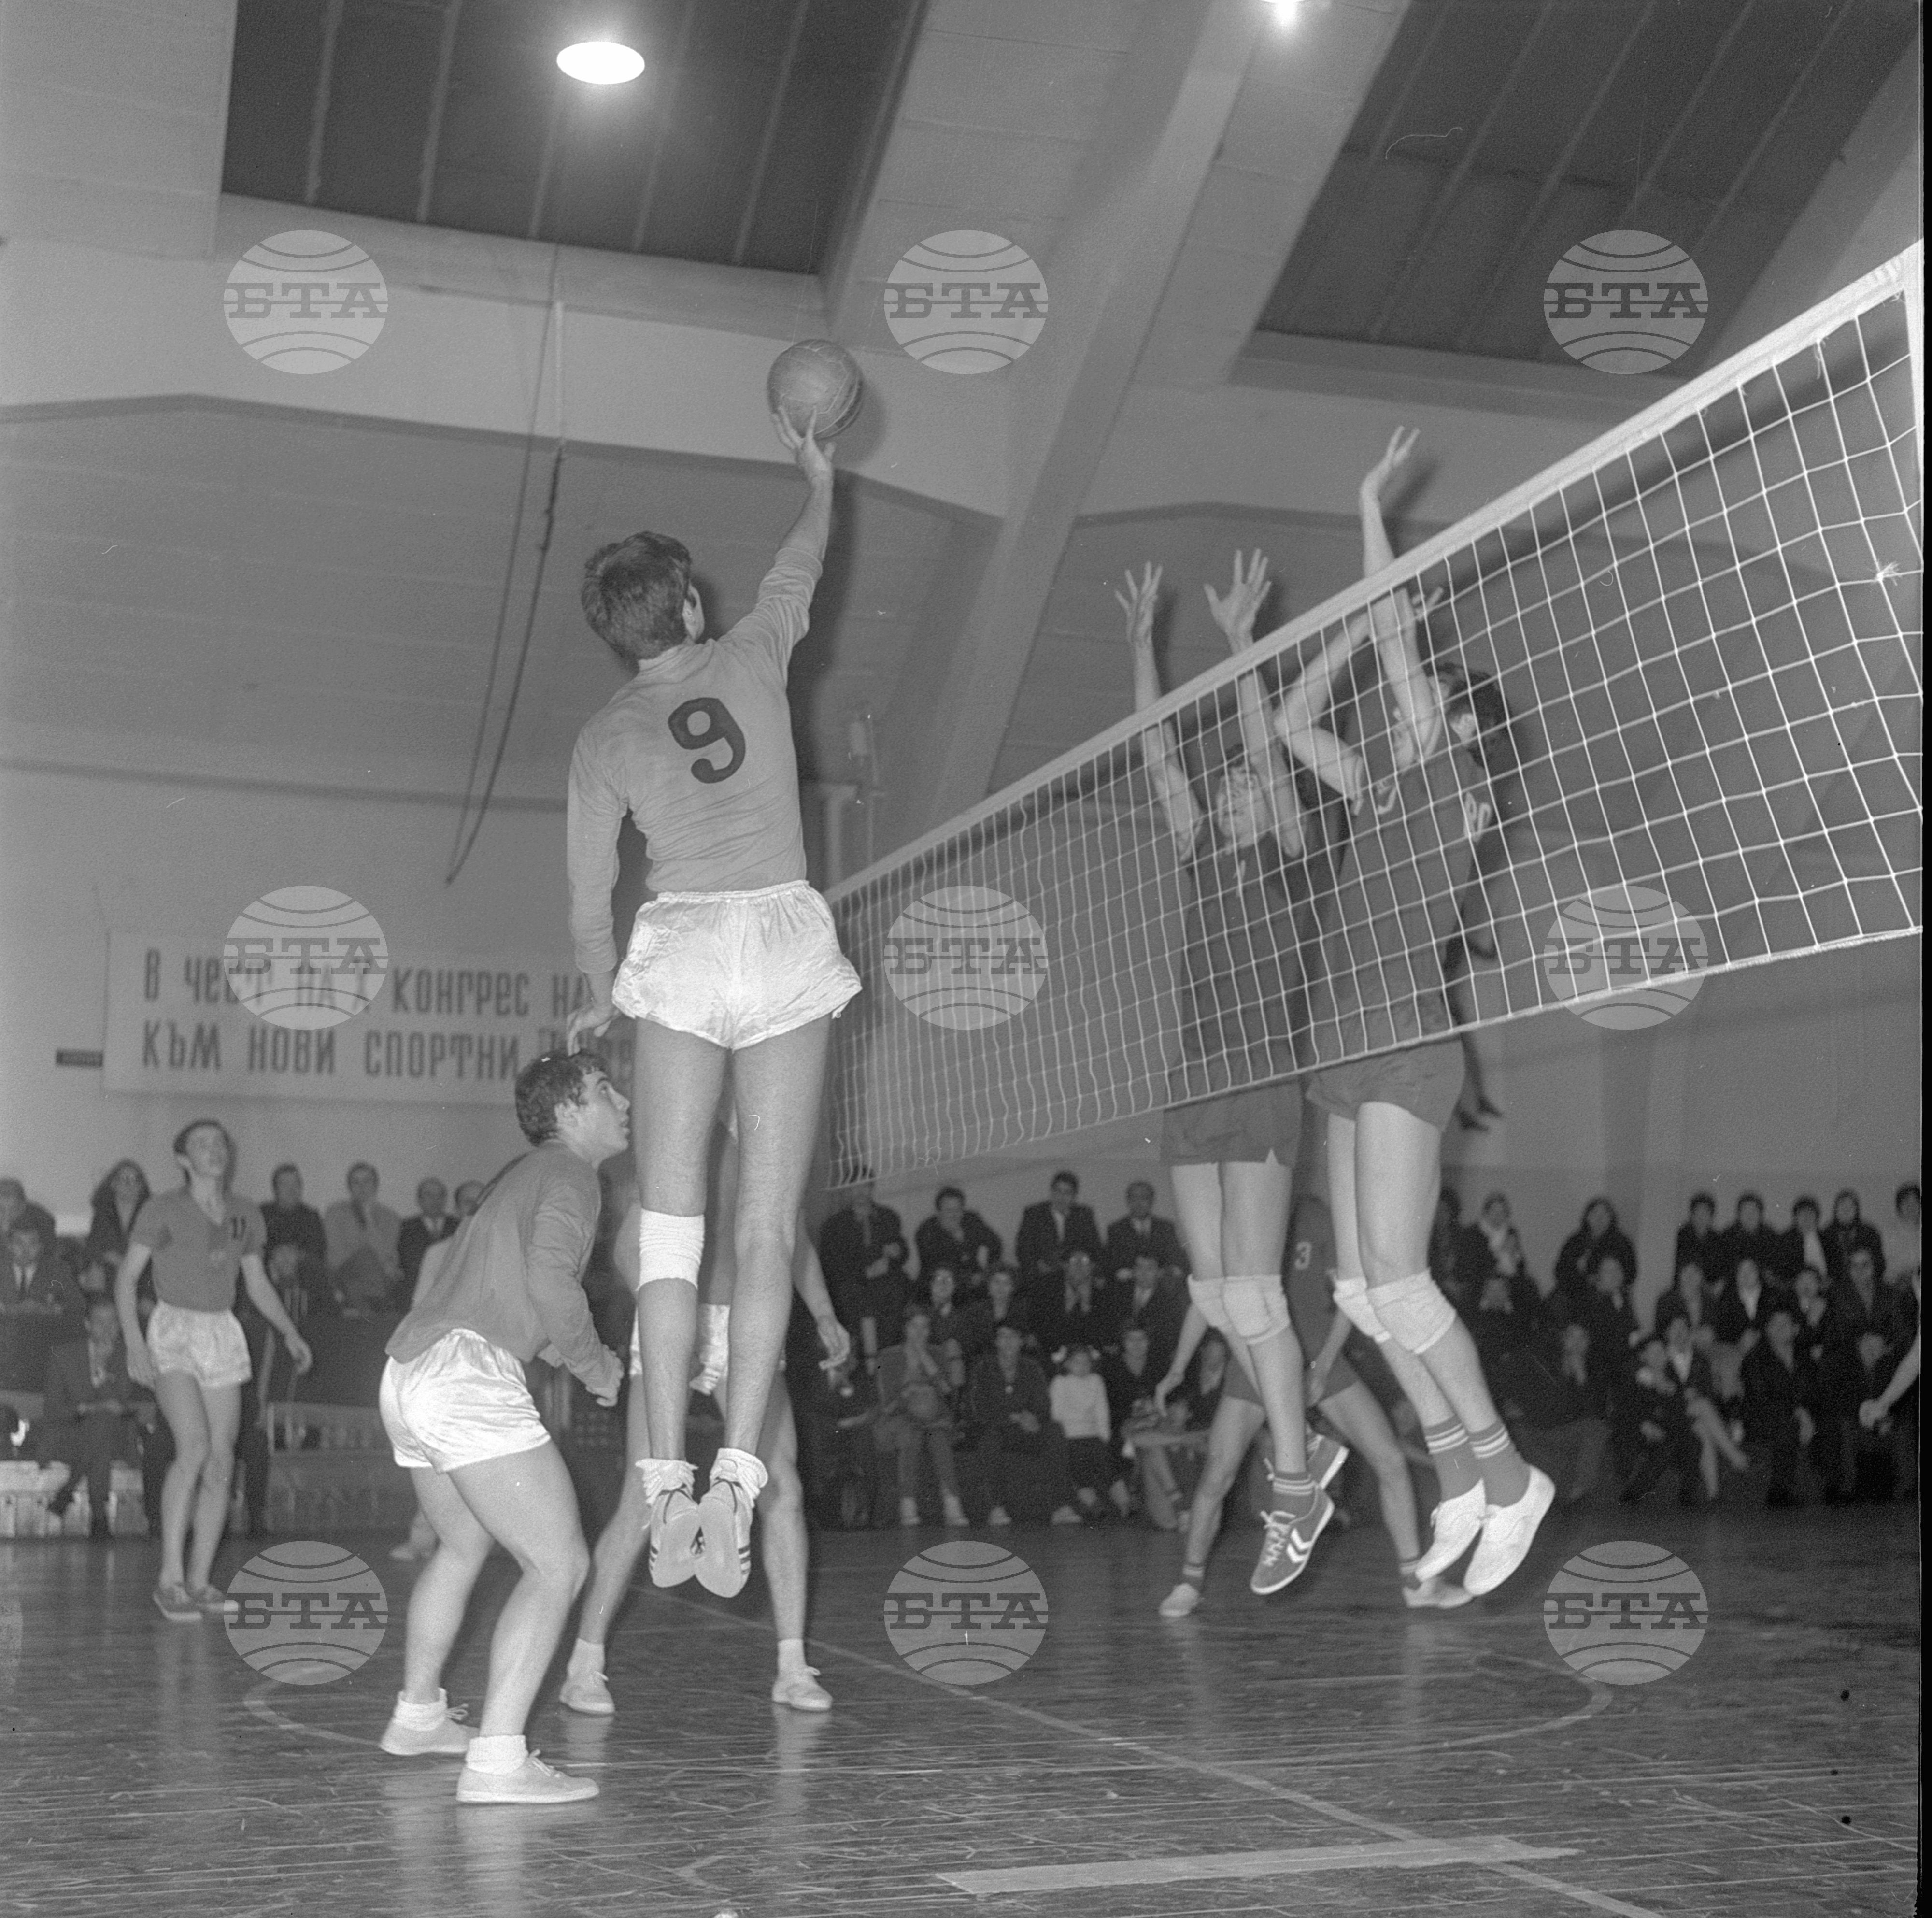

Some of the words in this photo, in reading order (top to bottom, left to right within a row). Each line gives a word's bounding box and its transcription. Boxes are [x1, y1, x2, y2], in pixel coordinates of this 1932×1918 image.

[667, 697, 746, 784] 9
[142, 1019, 221, 1070] КЪМ
[247, 1024, 336, 1074] НОВИ
[365, 1030, 519, 1081] СПОРТНИ
[1294, 1241, 1312, 1270] 3
